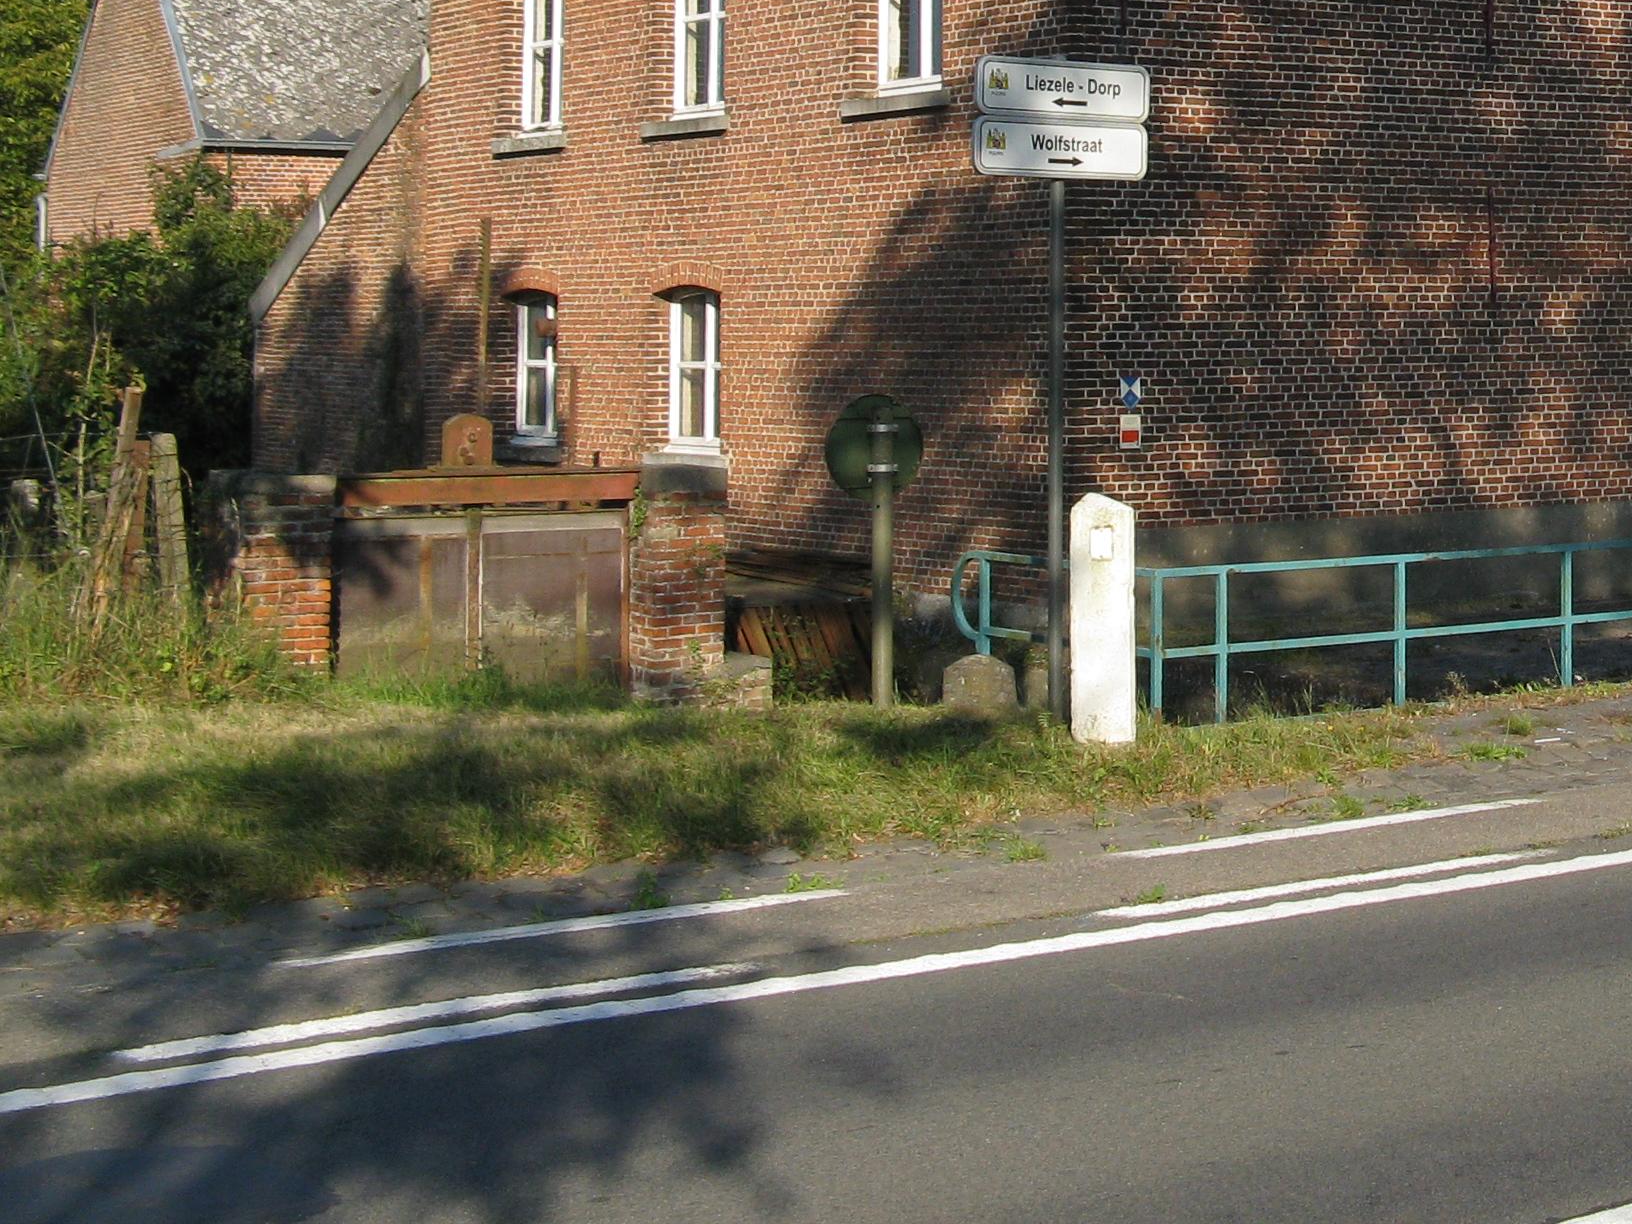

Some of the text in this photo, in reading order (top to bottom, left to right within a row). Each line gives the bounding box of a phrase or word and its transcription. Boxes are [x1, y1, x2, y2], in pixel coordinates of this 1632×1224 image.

[1025, 74, 1074, 93] Liezele
[1087, 78, 1121, 99] Dorp
[1031, 133, 1103, 153] Wolfstraat
